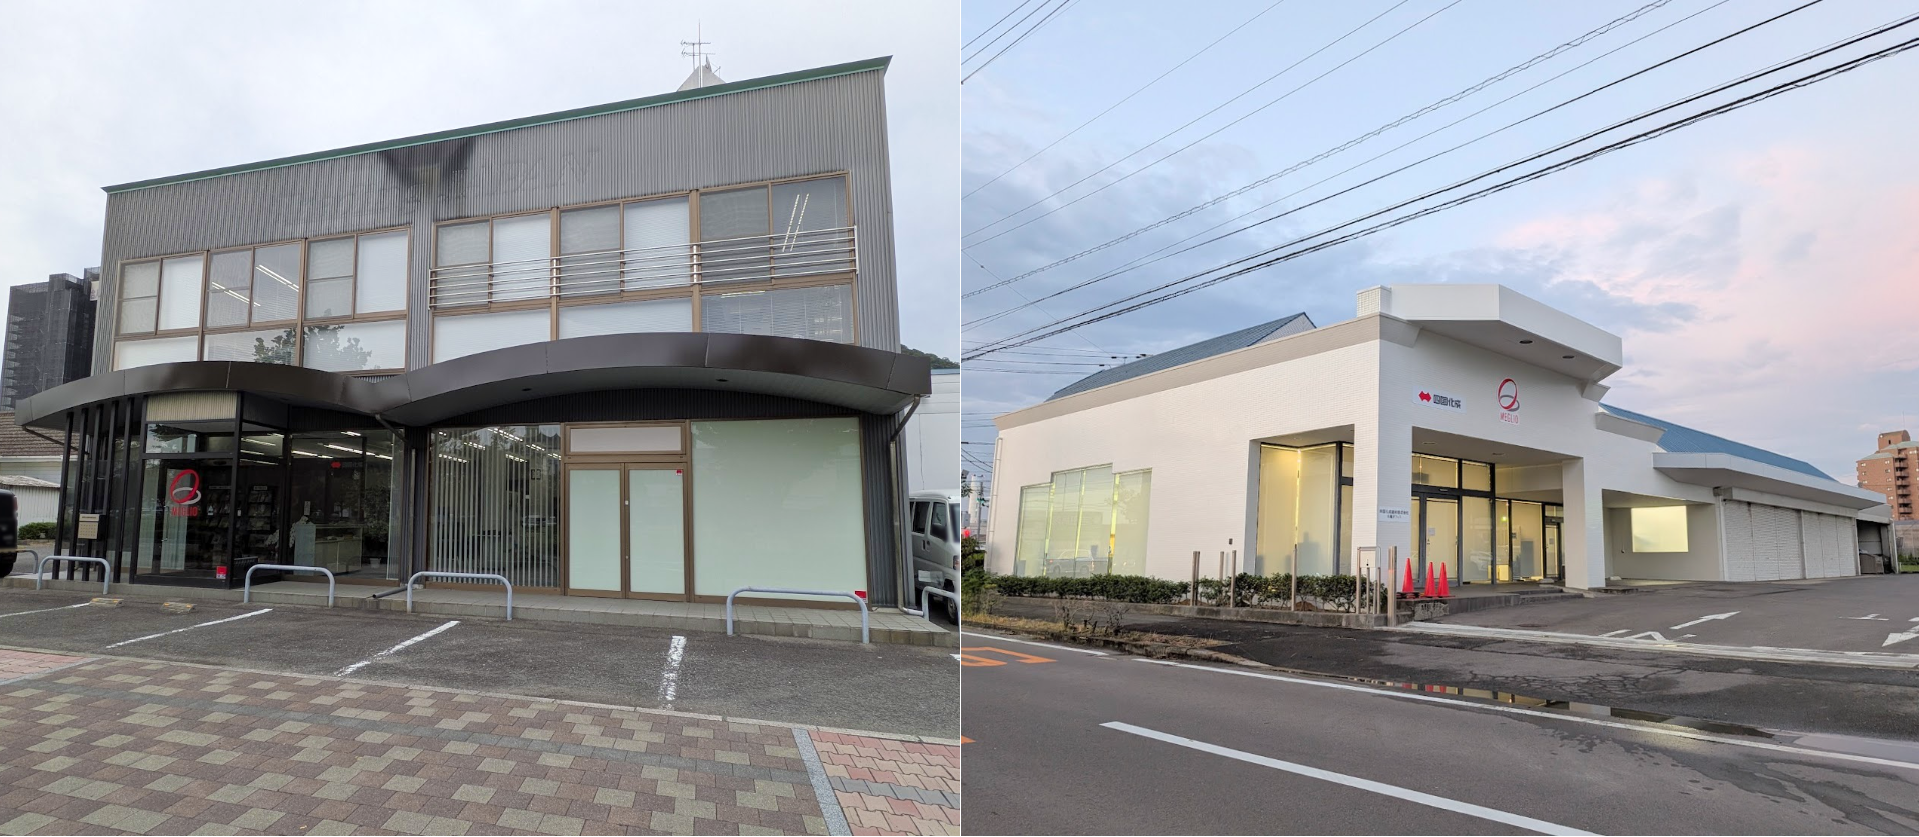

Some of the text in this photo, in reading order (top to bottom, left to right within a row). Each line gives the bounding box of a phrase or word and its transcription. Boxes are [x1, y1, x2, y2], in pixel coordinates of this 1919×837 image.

[1433, 394, 1462, 410] 四国化成
[1499, 411, 1519, 424] MEGLIO
[171, 506, 198, 517] MEGLIO
